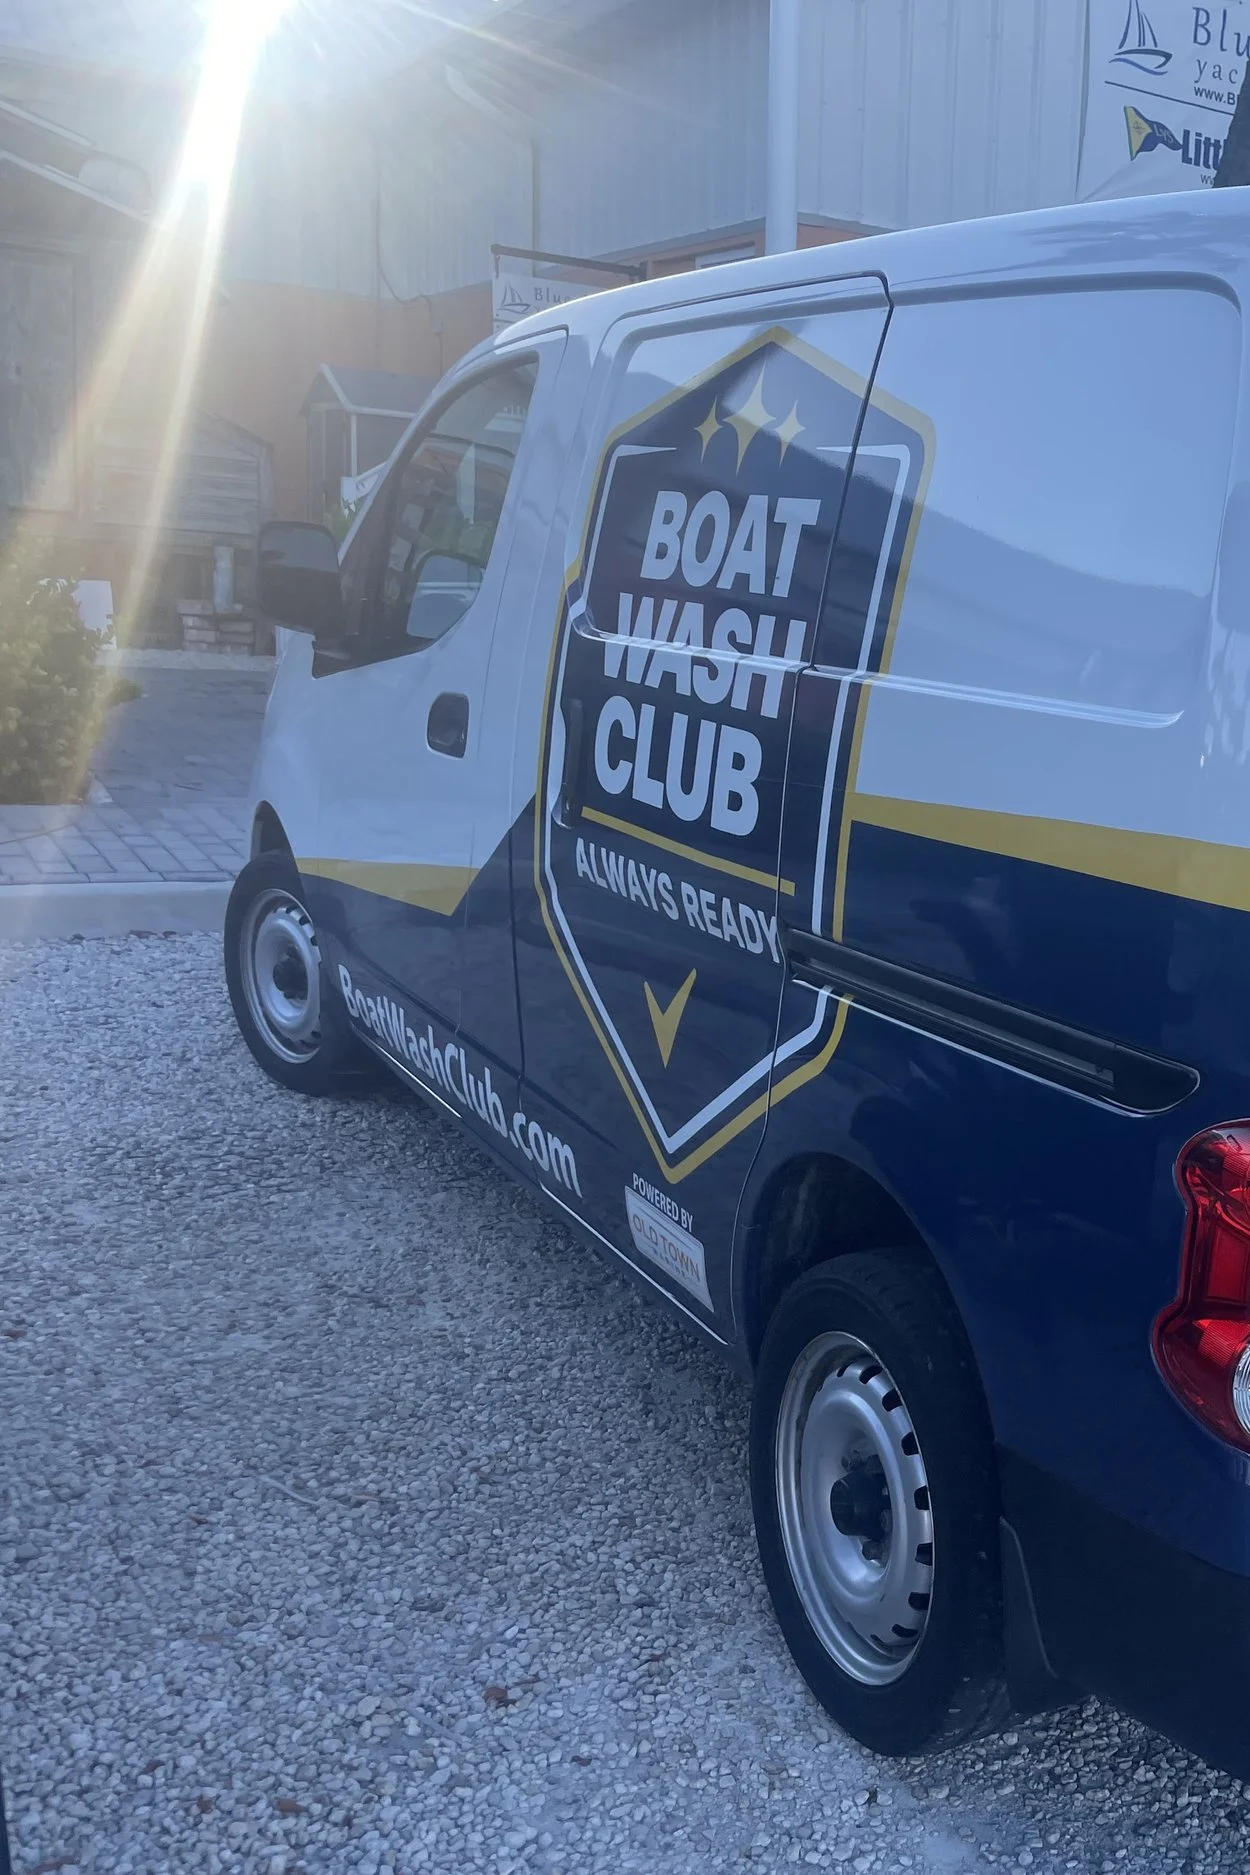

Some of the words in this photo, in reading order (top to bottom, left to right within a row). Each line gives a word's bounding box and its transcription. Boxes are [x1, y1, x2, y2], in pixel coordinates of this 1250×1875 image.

[1194, 59, 1238, 83] yac
[1181, 129, 1229, 170] Litt
[640, 490, 822, 598] BOAT
[603, 592, 807, 719] WASH
[595, 695, 762, 837] CLUB
[575, 837, 679, 922] ALWAYS
[680, 880, 782, 964] READY
[337, 963, 583, 1198] BoatWashClub.com
[632, 1214, 659, 1247] OLD
[659, 1234, 700, 1282] TOWN
[633, 1172, 679, 1222] POWERED
[681, 1207, 693, 1233] BY
